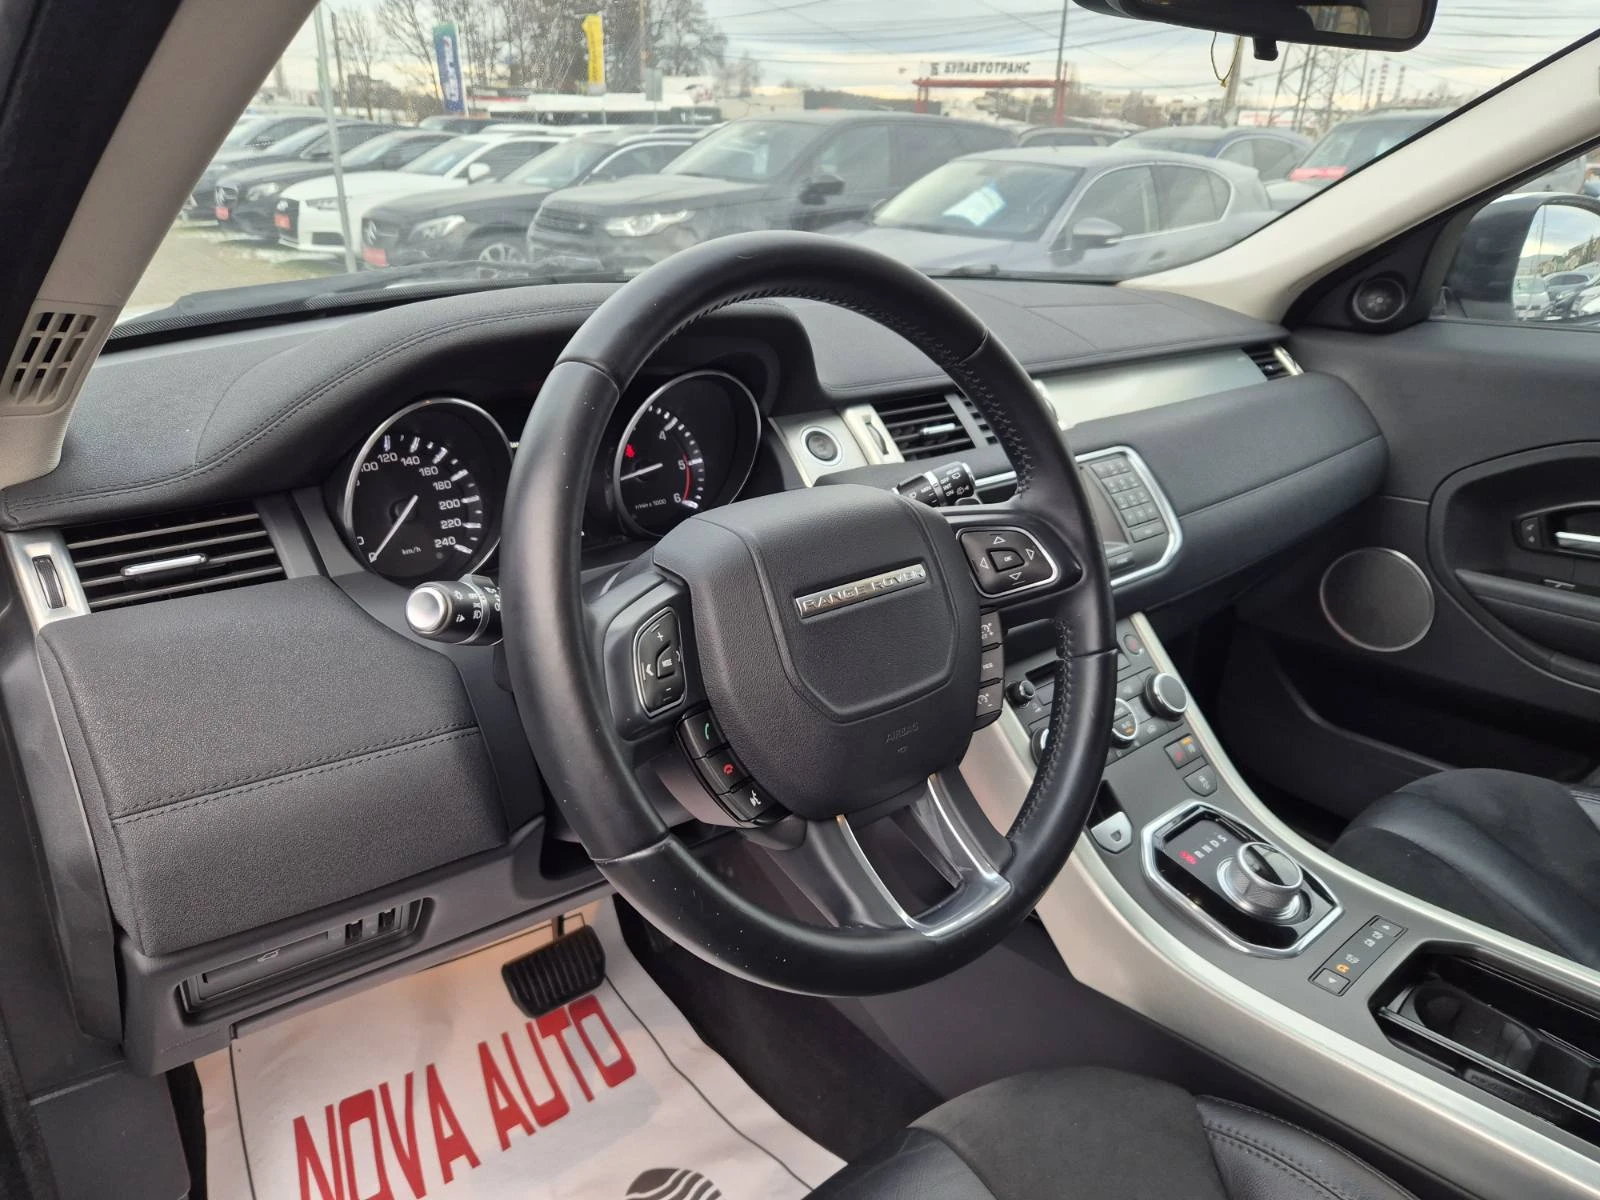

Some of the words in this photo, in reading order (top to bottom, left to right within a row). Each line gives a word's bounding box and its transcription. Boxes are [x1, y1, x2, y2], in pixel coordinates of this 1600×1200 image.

[659, 431, 667, 441] 4
[377, 452, 398, 463] 120
[401, 455, 420, 467] 140
[361, 461, 379, 472] 00
[678, 459, 686, 470] 5
[419, 465, 439, 477] 160
[433, 480, 452, 491] 180
[673, 493, 682, 503] 6
[439, 498, 461, 511] 200
[440, 518, 462, 530] 220
[434, 536, 457, 549] 240
[802, 584, 867, 612] RANGE
[871, 568, 924, 592] ROVER
[293, 1063, 481, 1200] NOVA
[478, 994, 637, 1151] AUTO
